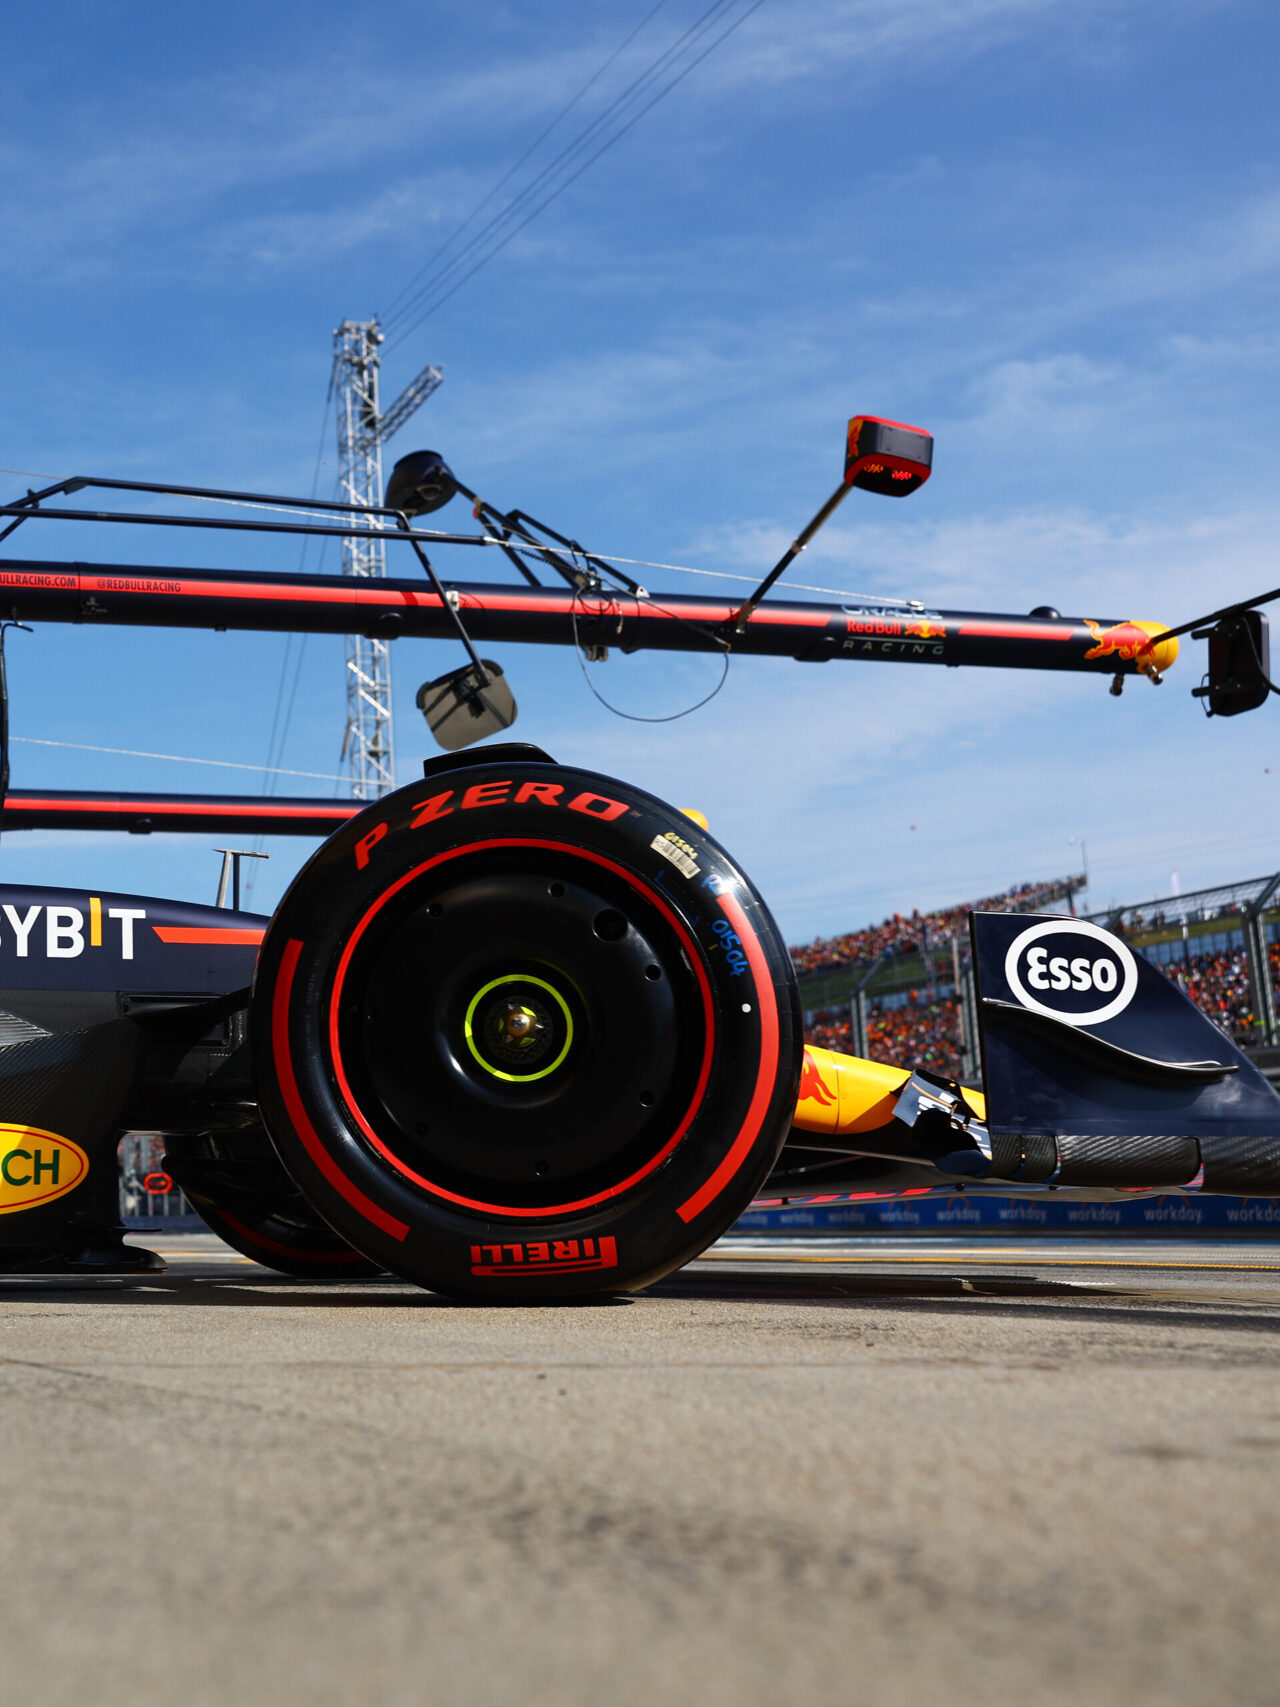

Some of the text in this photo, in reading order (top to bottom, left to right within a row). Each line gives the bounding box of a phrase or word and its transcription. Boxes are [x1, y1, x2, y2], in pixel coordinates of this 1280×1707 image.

[97, 578, 181, 593] @REDBULLRACING
[846, 617, 902, 635] Red Bull
[842, 640, 944, 656] RACING
[354, 780, 631, 871] P ZERO
[711, 919, 749, 976] 01504
[936, 1207, 982, 1224] workday
[999, 1206, 1048, 1224] workday
[1068, 1206, 1121, 1225] workday
[1144, 1206, 1203, 1225] workday
[470, 1236, 619, 1277] PIRELLI
